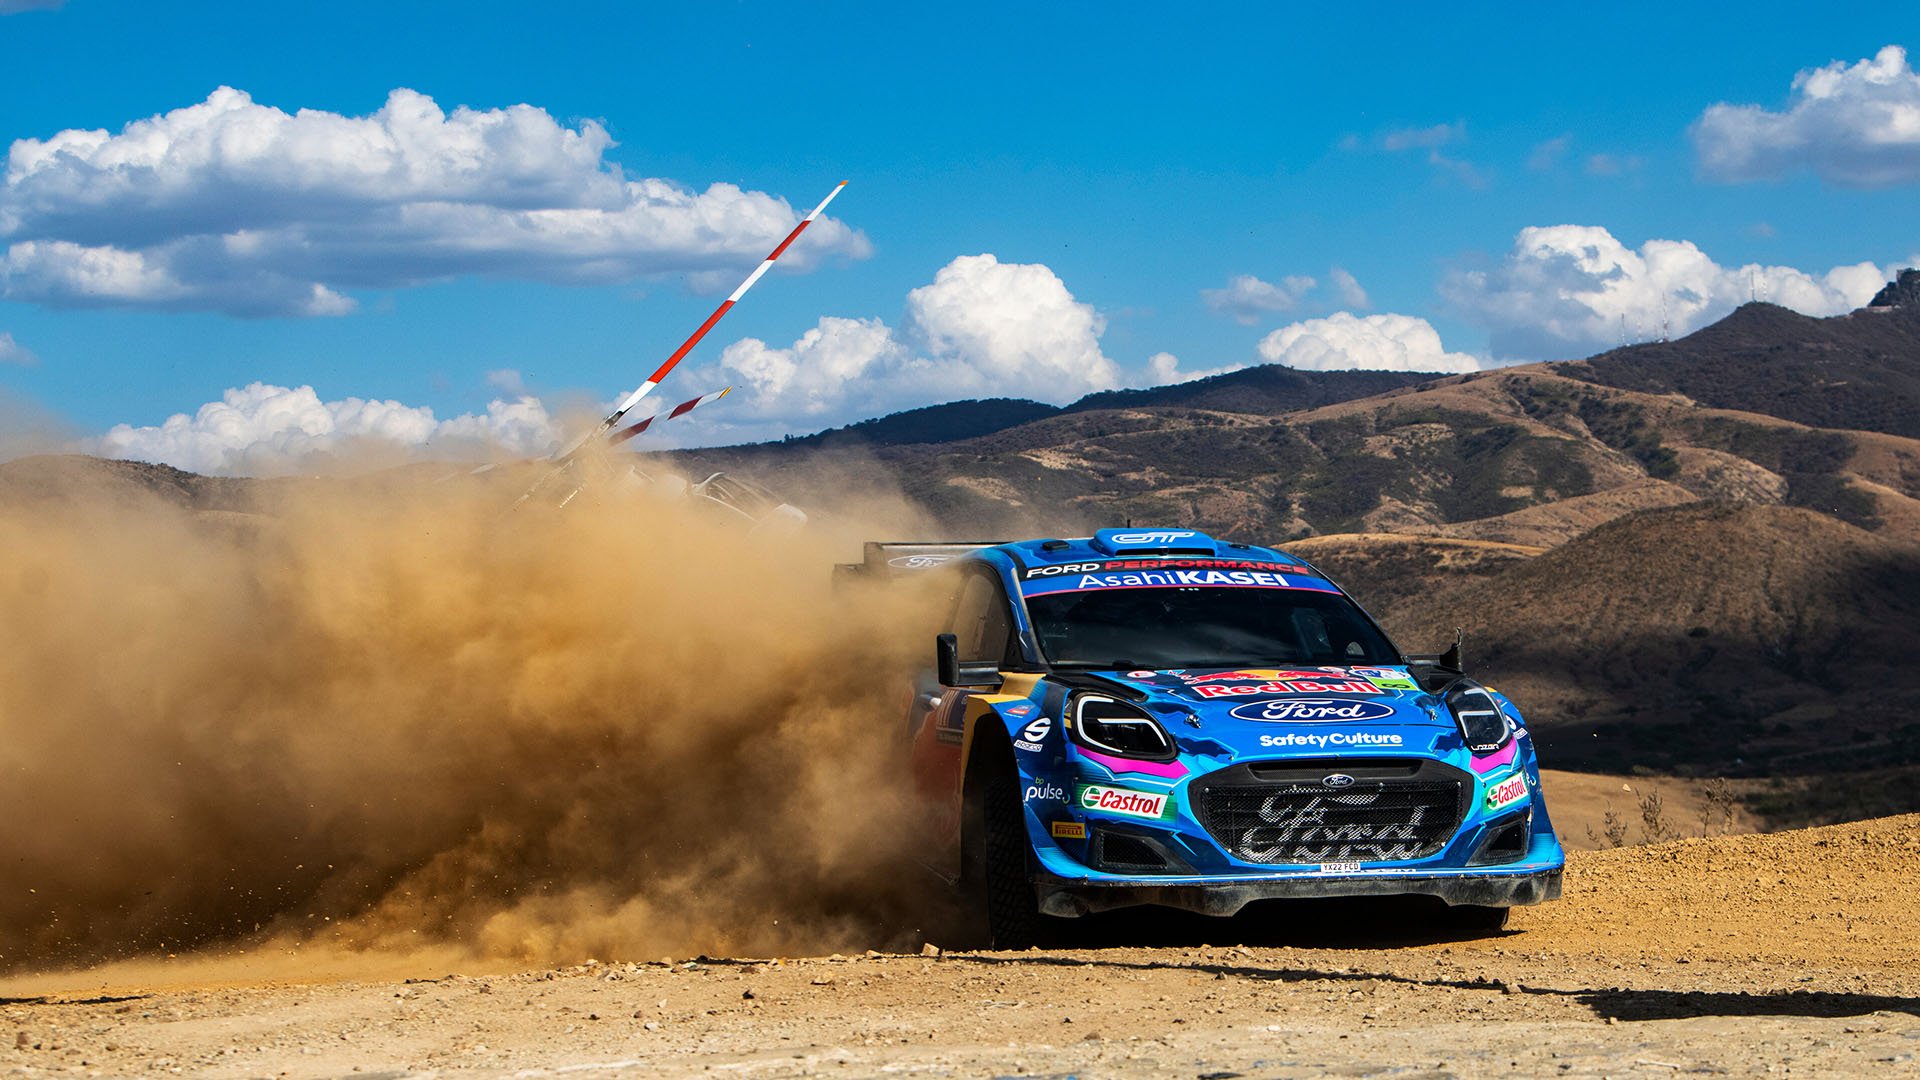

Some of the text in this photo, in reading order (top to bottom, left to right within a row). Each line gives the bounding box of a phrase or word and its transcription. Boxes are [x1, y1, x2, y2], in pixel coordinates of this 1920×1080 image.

[1026, 560, 1309, 578] FORD PERFORMANCE
[1192, 682, 1384, 698] Red Bull
[1262, 700, 1366, 719] Ford
[1260, 732, 1402, 748] SafetyCulture
[1035, 777, 1044, 785] bp
[1498, 776, 1526, 804] Castrol
[1025, 783, 1063, 802] pulse
[1100, 790, 1161, 815] Castrol
[1055, 824, 1083, 836] PIRELLI
